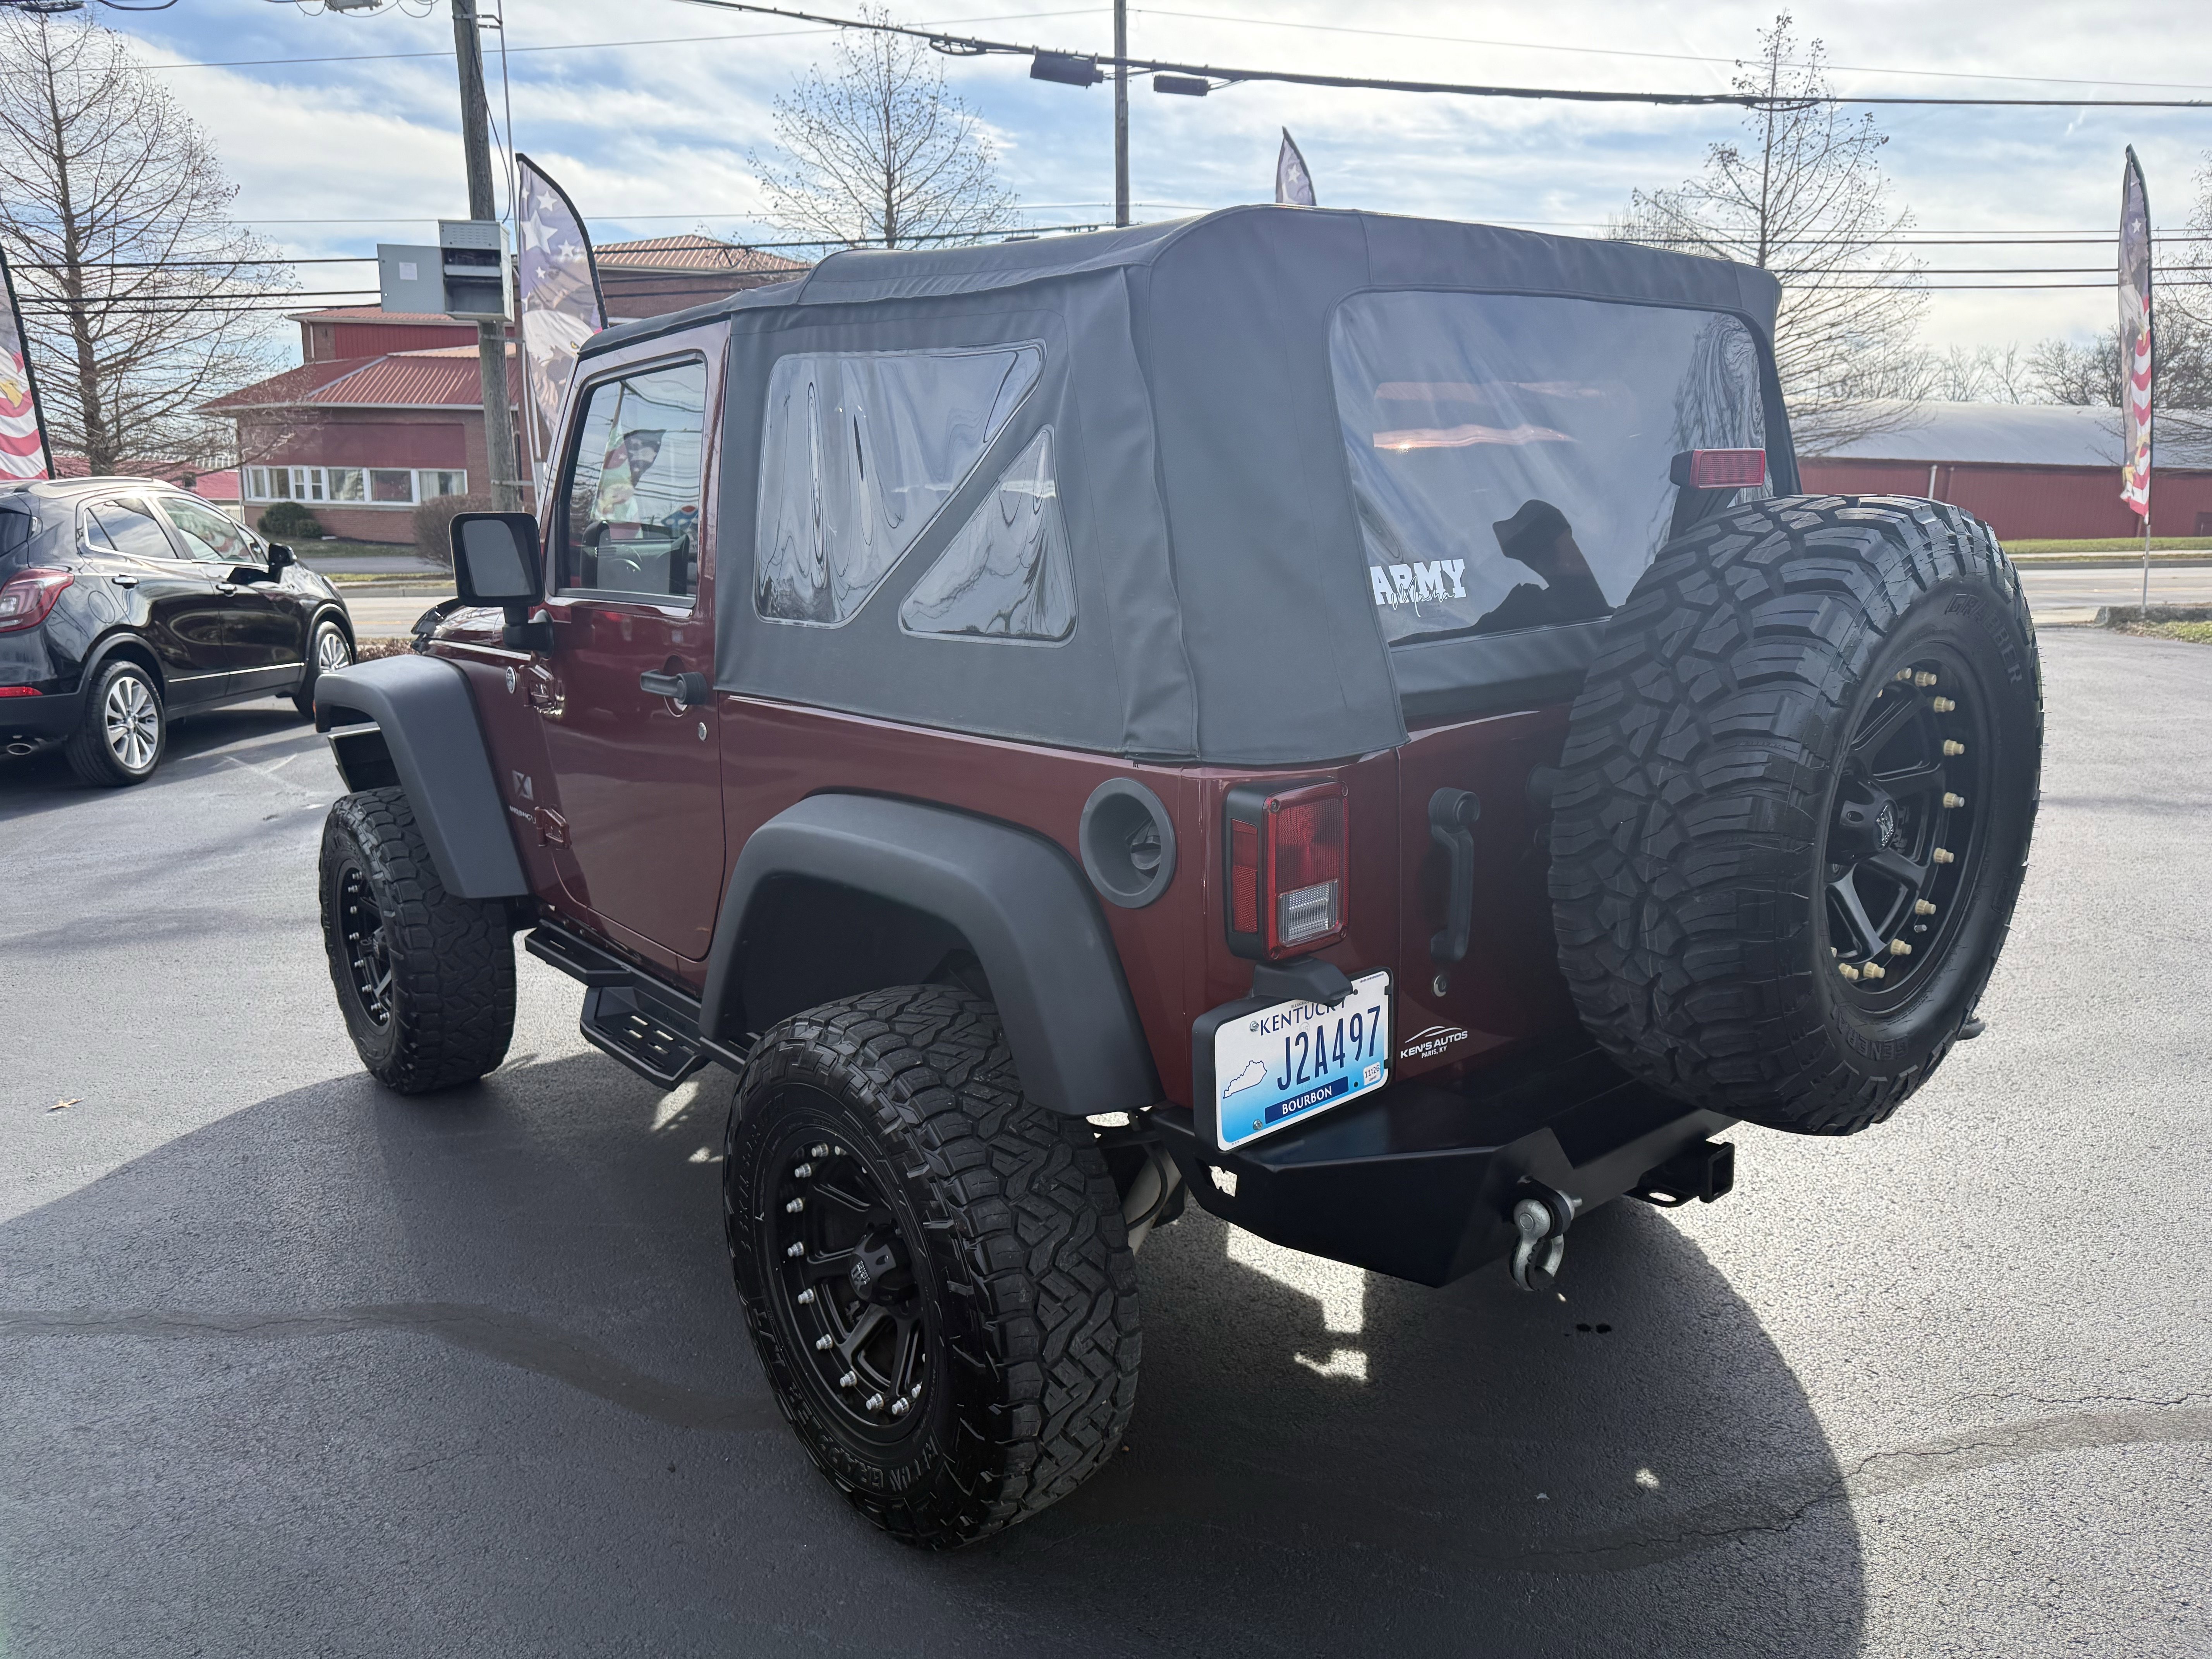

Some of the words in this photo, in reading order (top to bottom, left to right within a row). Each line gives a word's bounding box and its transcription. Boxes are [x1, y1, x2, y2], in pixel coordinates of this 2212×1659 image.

[1370, 559, 1467, 605] ARMY
[1277, 1005, 1381, 1091] J2A497
[1400, 1041, 1432, 1059] KEN'S
[1434, 1030, 1468, 1048] AUTOS
[1421, 1048, 1438, 1058] PARIS,
[1282, 1085, 1332, 1115] BOURBON
